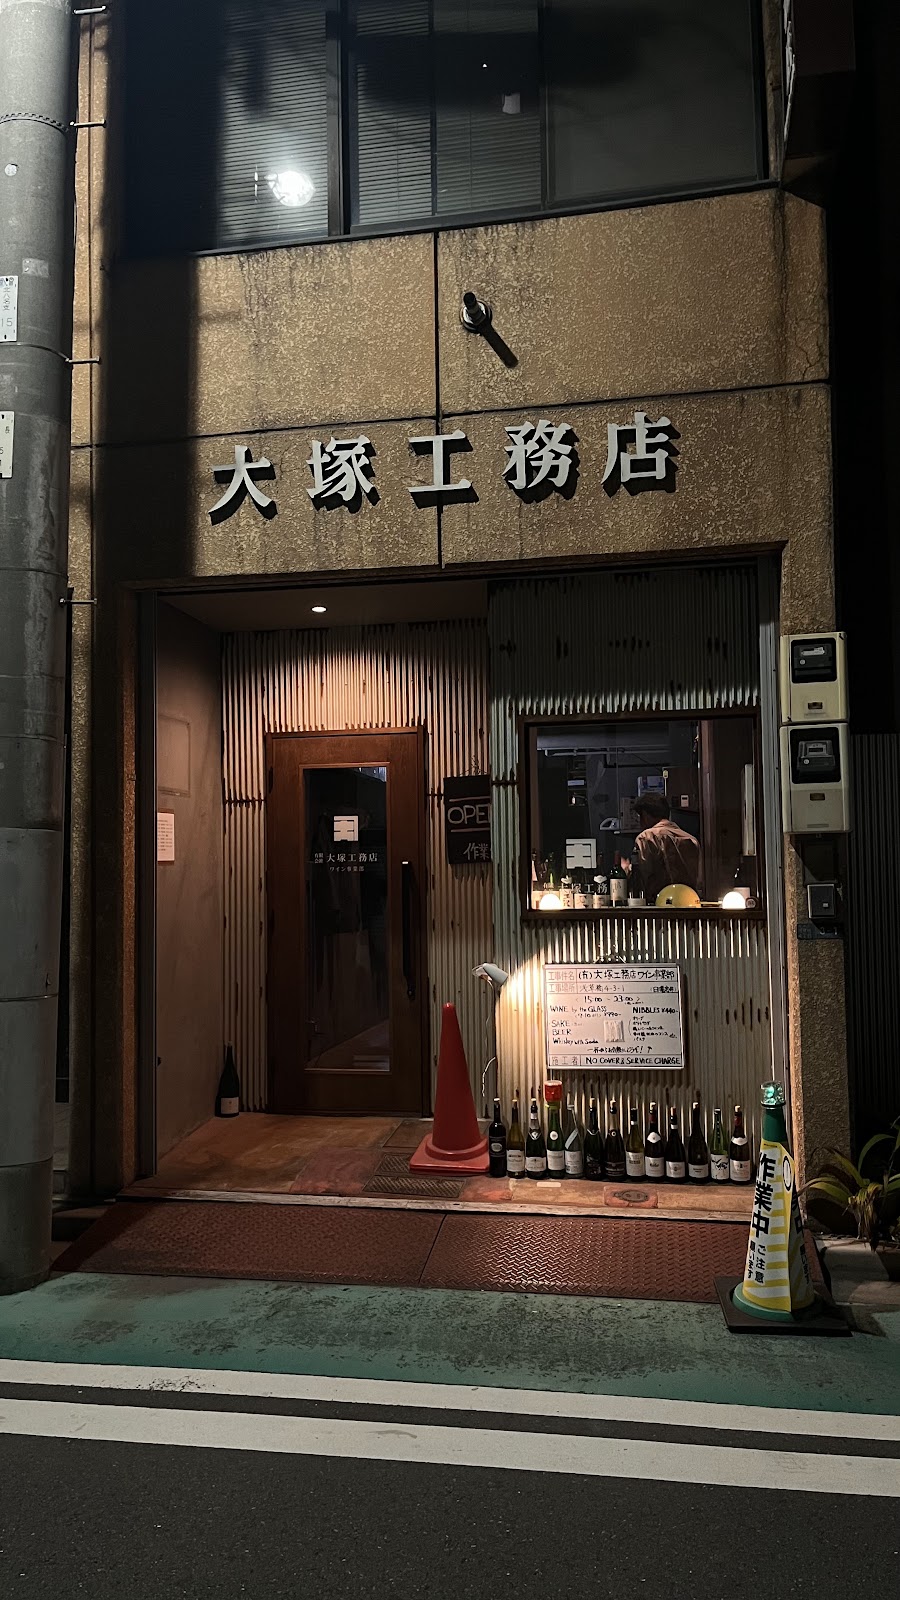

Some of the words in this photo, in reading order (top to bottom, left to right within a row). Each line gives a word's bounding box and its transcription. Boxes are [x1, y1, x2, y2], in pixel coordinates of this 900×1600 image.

[207, 411, 672, 515] 大塚工務店
[447, 804, 492, 824] OPE
[326, 852, 378, 863] 大塚工務店
[588, 1005, 607, 1013] GLASS
[632, 1006, 660, 1014] NIBBLES
[551, 1019, 571, 1027] SAKE
[552, 1028, 572, 1036] BEER
[653, 1057, 680, 1065] CHARGE
[752, 1151, 777, 1239] 作業中
